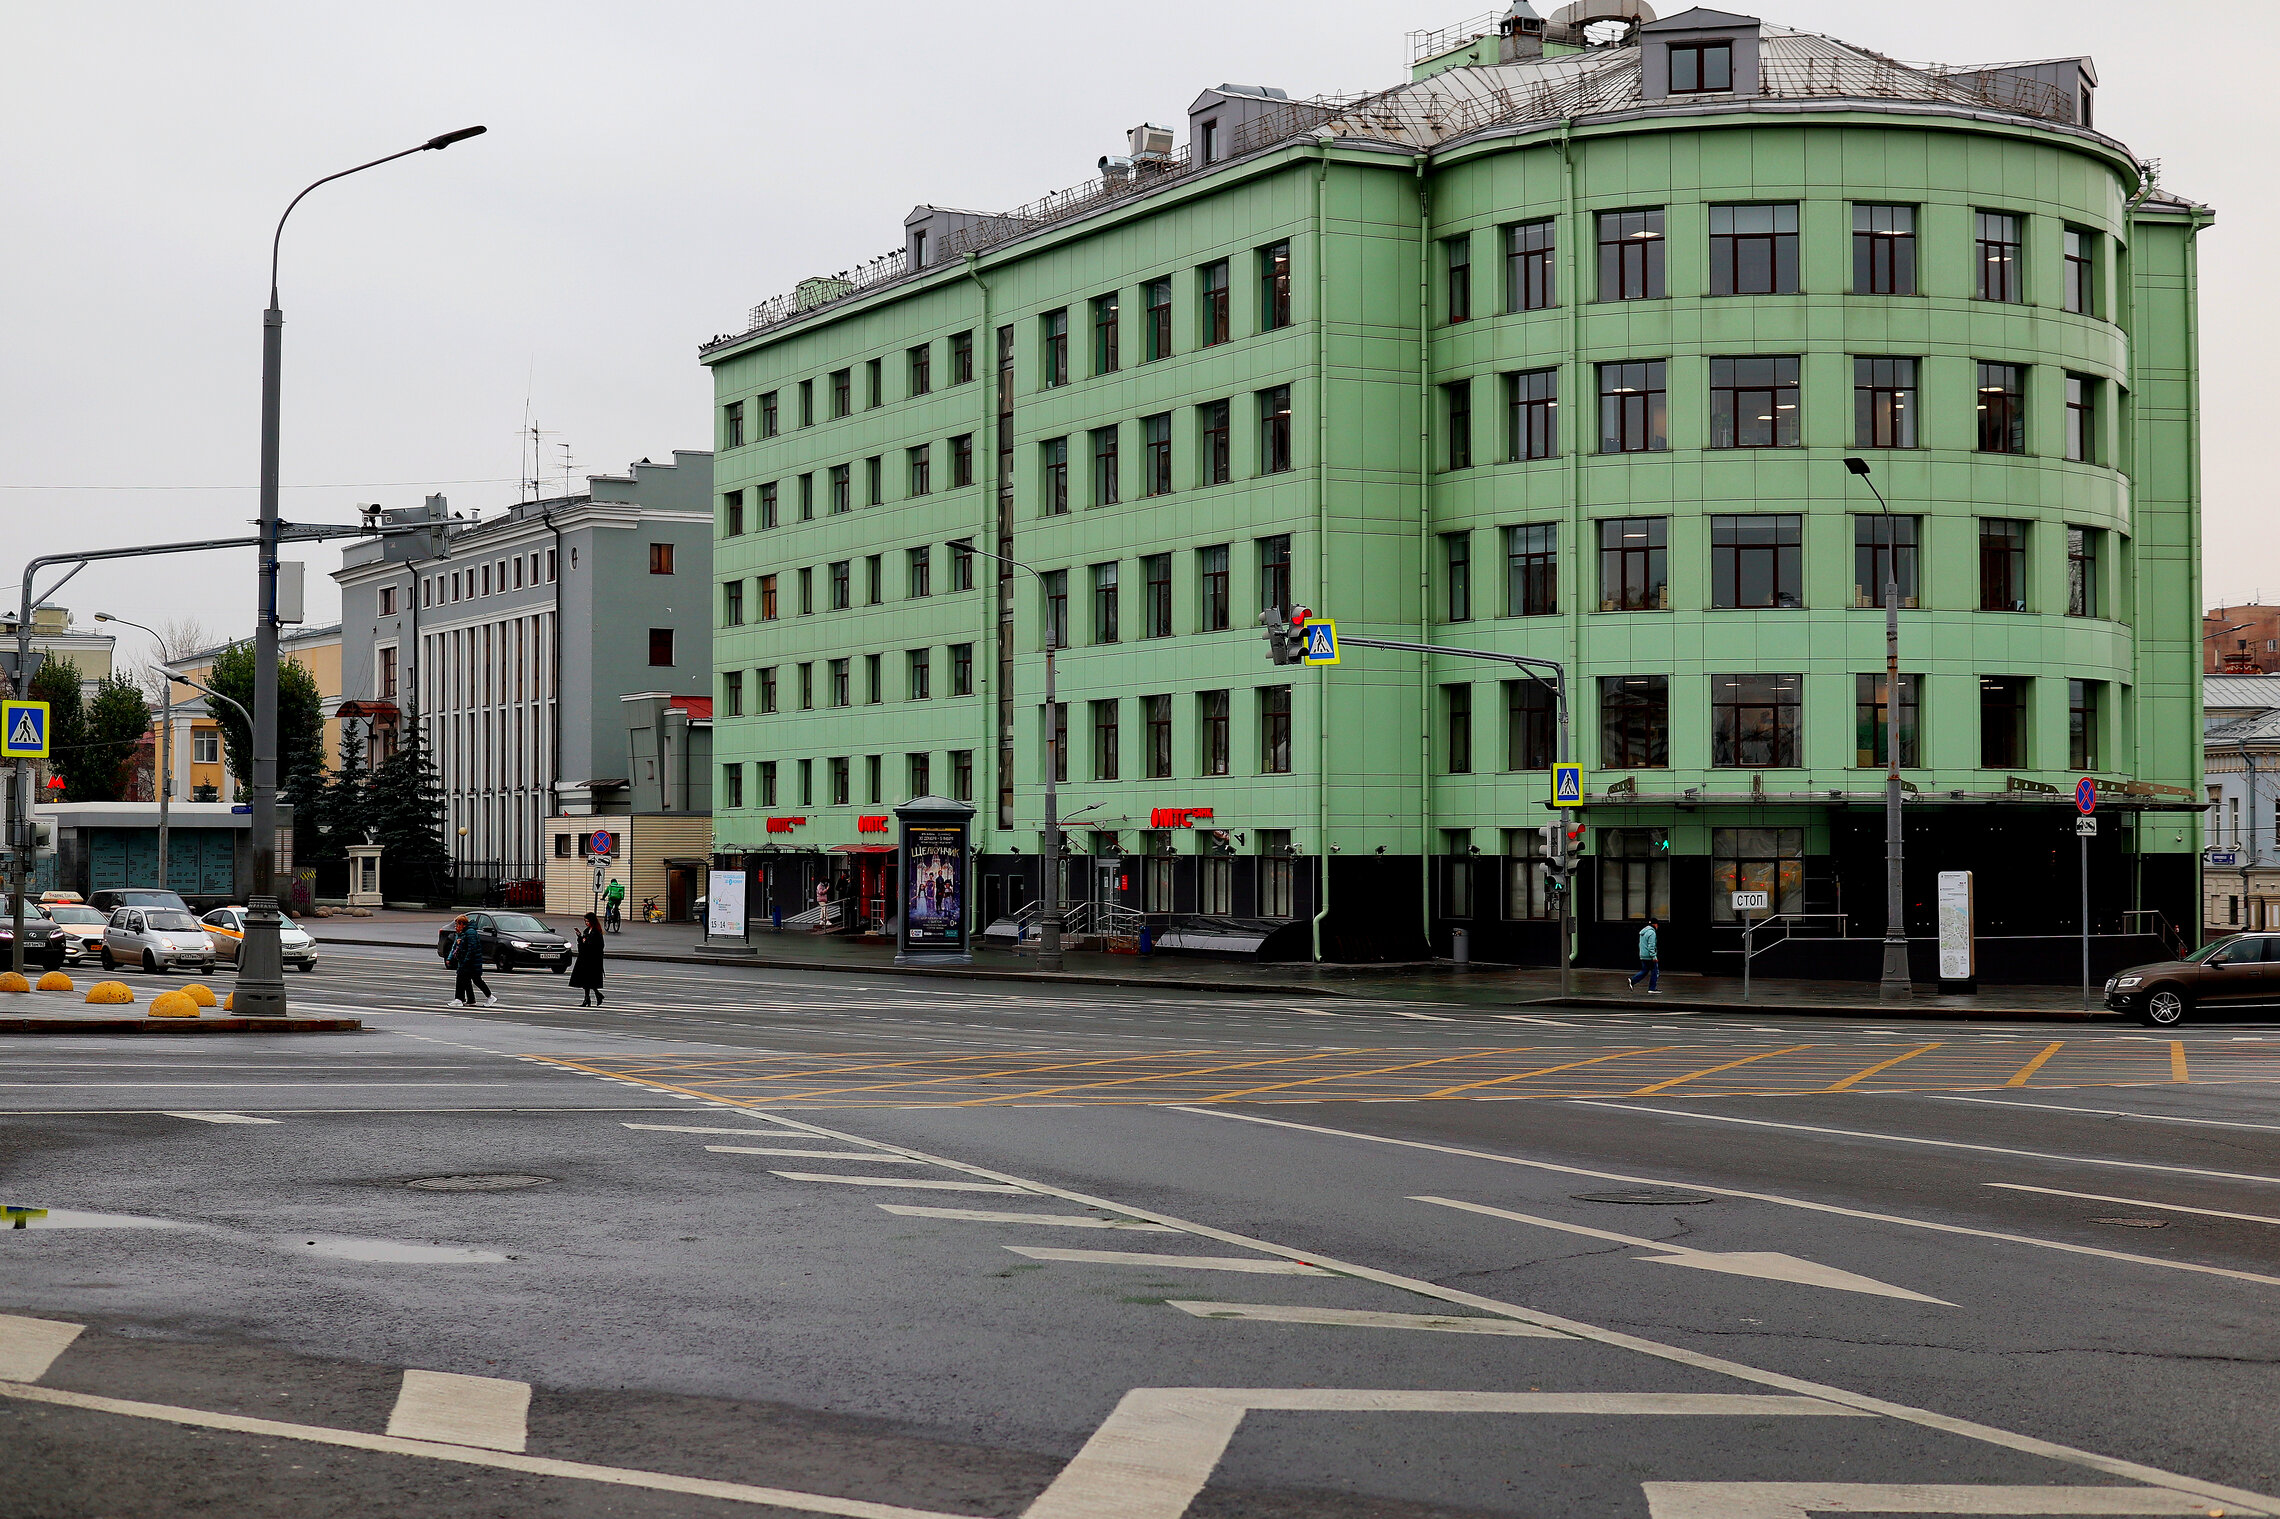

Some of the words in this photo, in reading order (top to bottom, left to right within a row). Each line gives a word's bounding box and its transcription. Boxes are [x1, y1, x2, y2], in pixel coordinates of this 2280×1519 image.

[863, 815, 889, 832] МТС
[1158, 808, 1193, 828] МТС
[1192, 807, 1213, 818] БАНК
[771, 817, 794, 833] МТС
[910, 846, 960, 858] ЩЕЛКУНЧИК
[1737, 895, 1763, 906] СТОП
[711, 920, 718, 929] 15
[720, 920, 726, 929] 14
[949, 919, 957, 927] 0+
